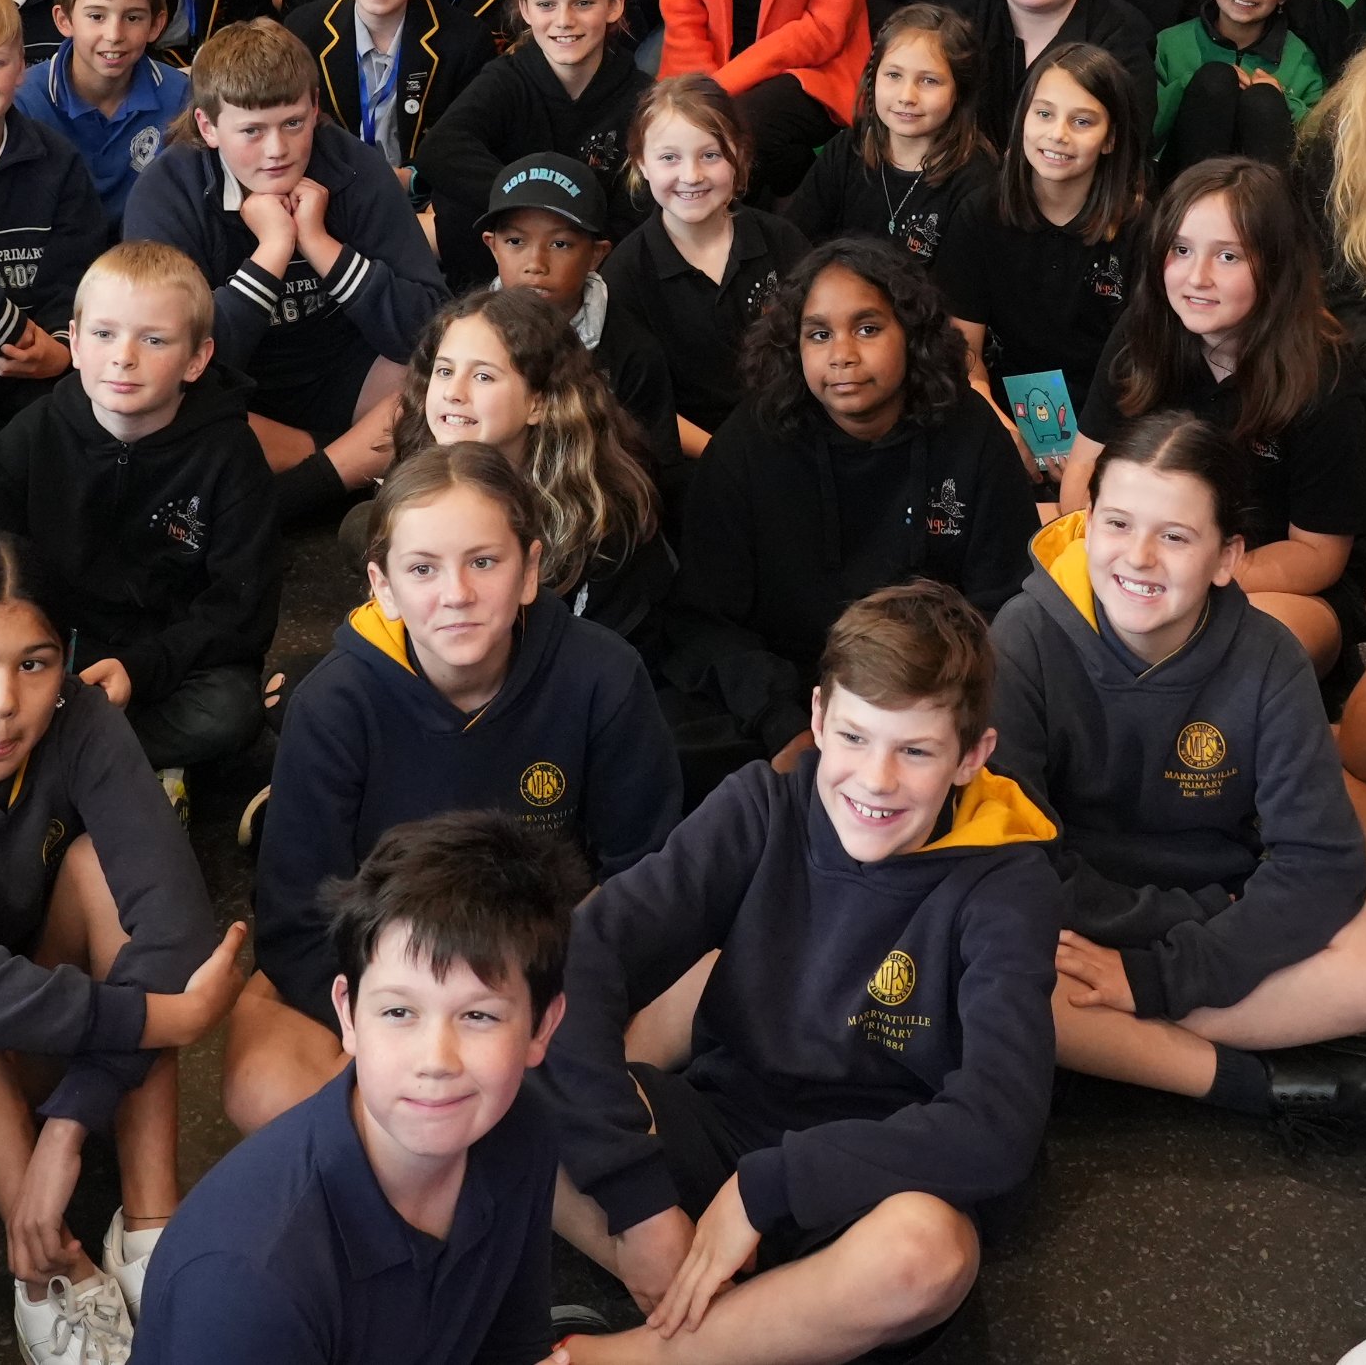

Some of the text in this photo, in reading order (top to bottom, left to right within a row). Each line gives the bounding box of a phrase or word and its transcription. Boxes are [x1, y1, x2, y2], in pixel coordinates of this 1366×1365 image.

[1179, 780, 1224, 789] PRIMARY
[847, 1009, 931, 1027] MARRYATVILLE
[863, 1021, 913, 1039] PRIMARY
[882, 1036, 905, 1052] 1884
